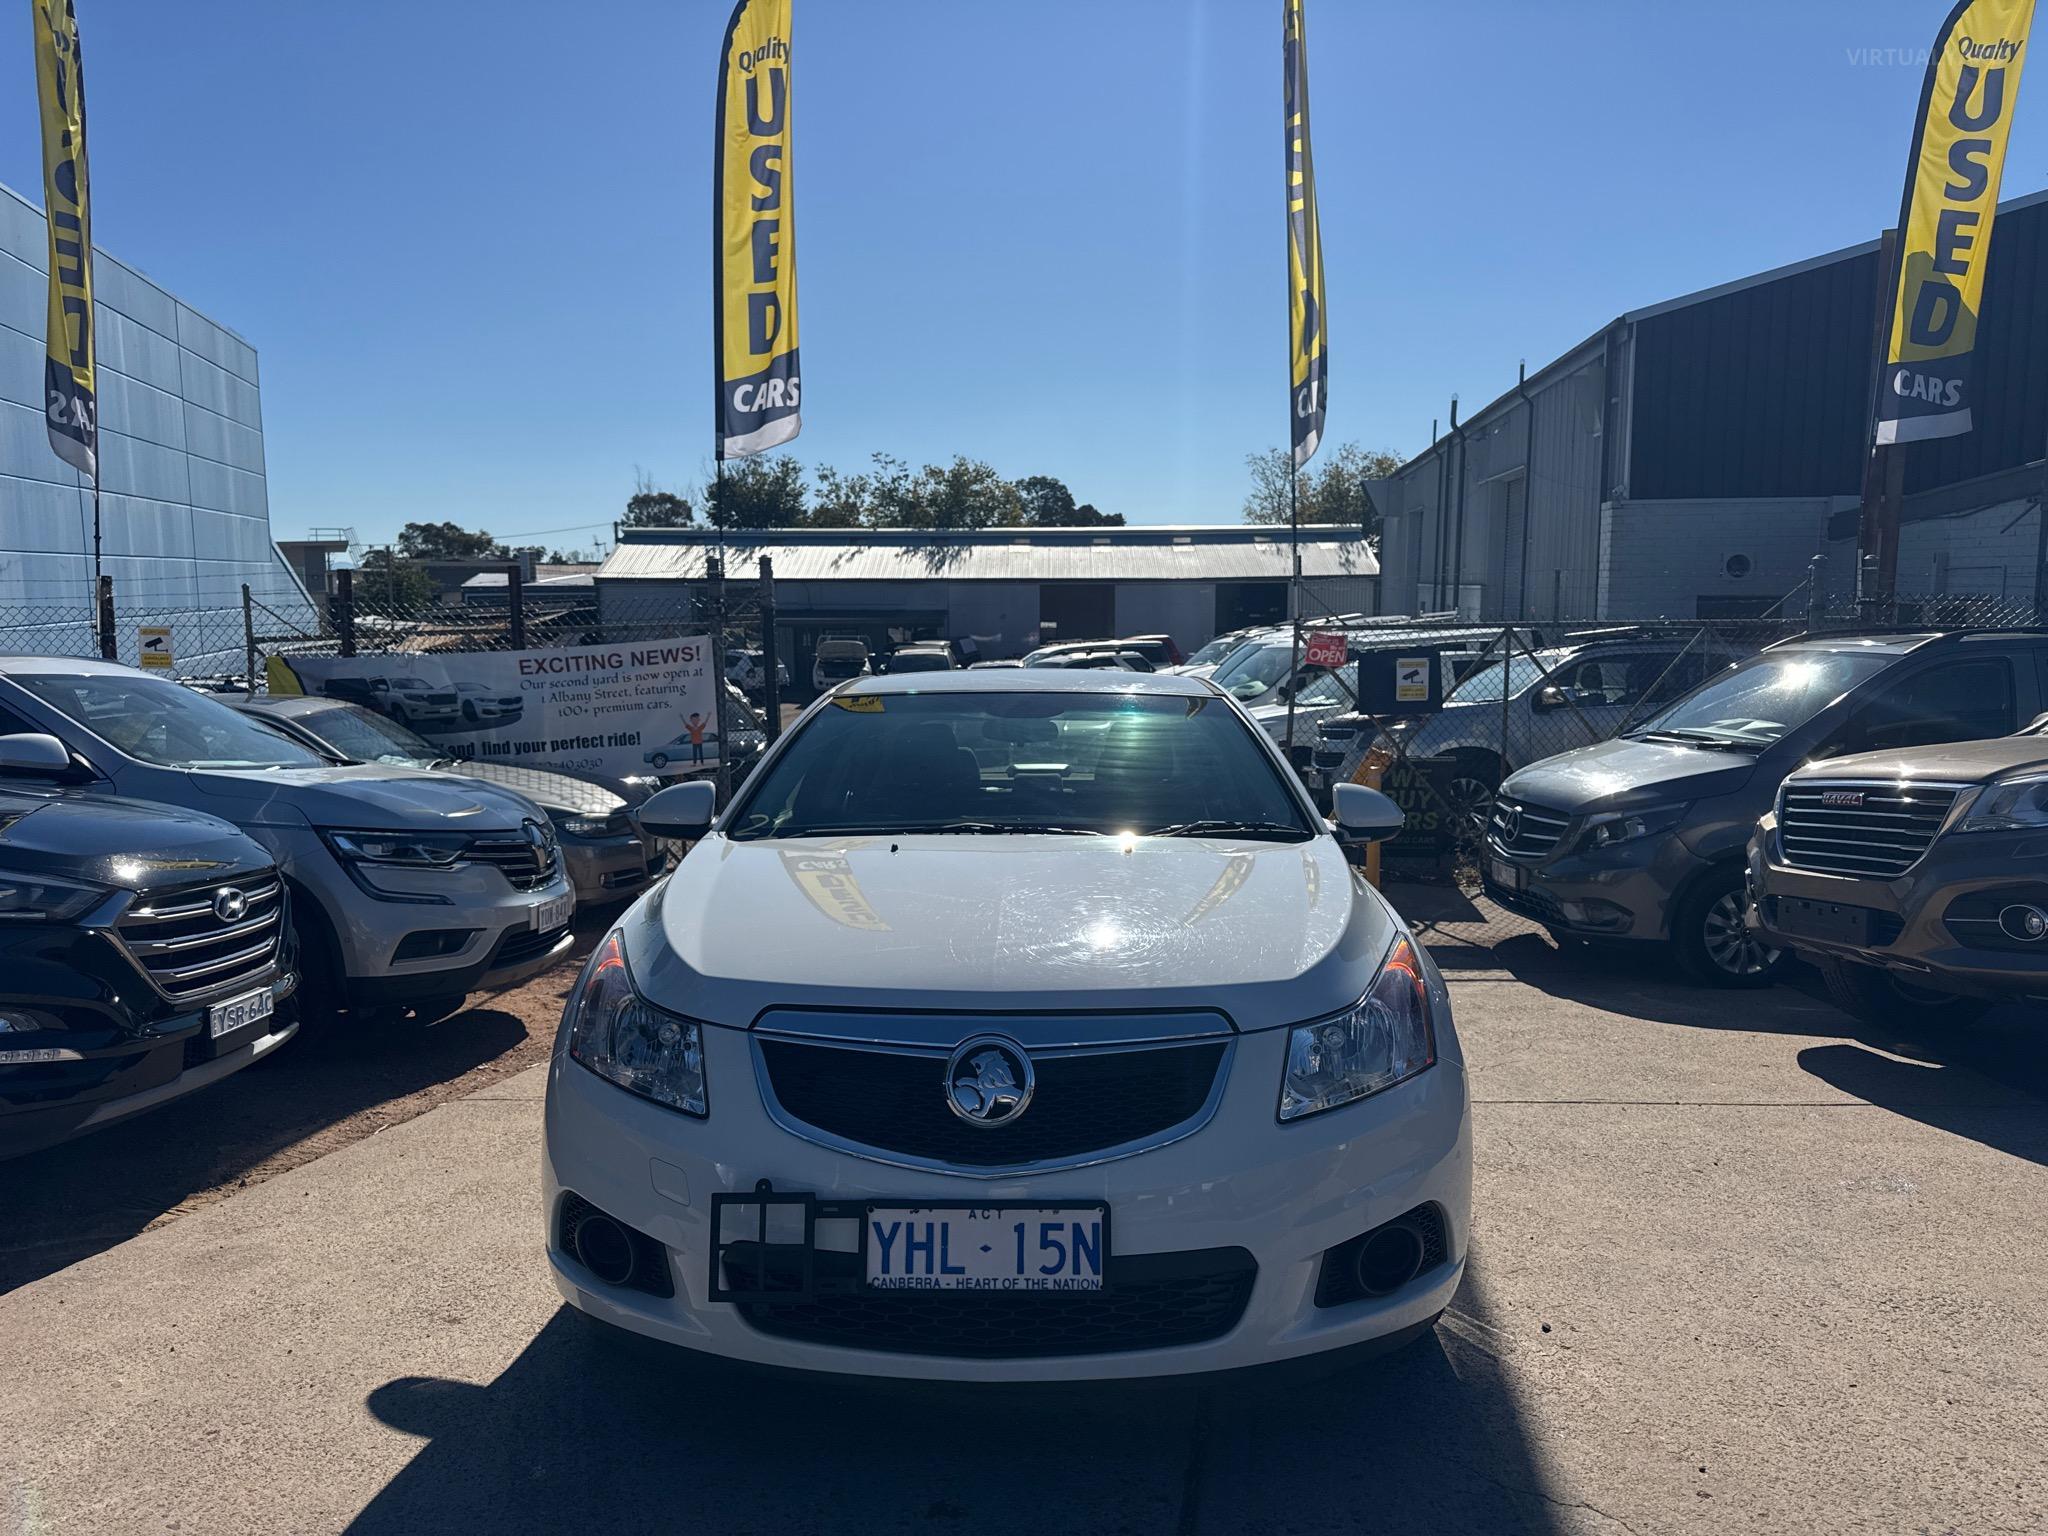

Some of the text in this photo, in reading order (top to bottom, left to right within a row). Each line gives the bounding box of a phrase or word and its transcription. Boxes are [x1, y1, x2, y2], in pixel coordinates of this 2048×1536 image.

[1958, 36, 2024, 63] Qualty
[746, 68, 786, 355] USED
[1910, 64, 2005, 346] USED
[734, 377, 800, 413] CARS
[1893, 369, 1963, 406] CARS
[519, 645, 701, 675] EXCITING NEWS!
[1308, 648, 1345, 663] OPEN
[520, 667, 704, 691] Our second yard is now open at
[547, 689, 592, 705] Albany
[634, 682, 688, 697] featuring
[592, 701, 645, 718] premium
[481, 739, 511, 756] find
[513, 740, 548, 756] your
[550, 735, 605, 754] perfect
[607, 731, 642, 748] ride!
[968, 1209, 1004, 1220] ACT
[872, 1221, 1101, 1276] YHL 15N
[872, 1277, 941, 1290] CANBERRA
[956, 1278, 999, 1289] HEART
[1003, 1278, 1020, 1290] OF
[1025, 1278, 1048, 1289] THE
[1053, 1278, 1100, 1290] NATION
